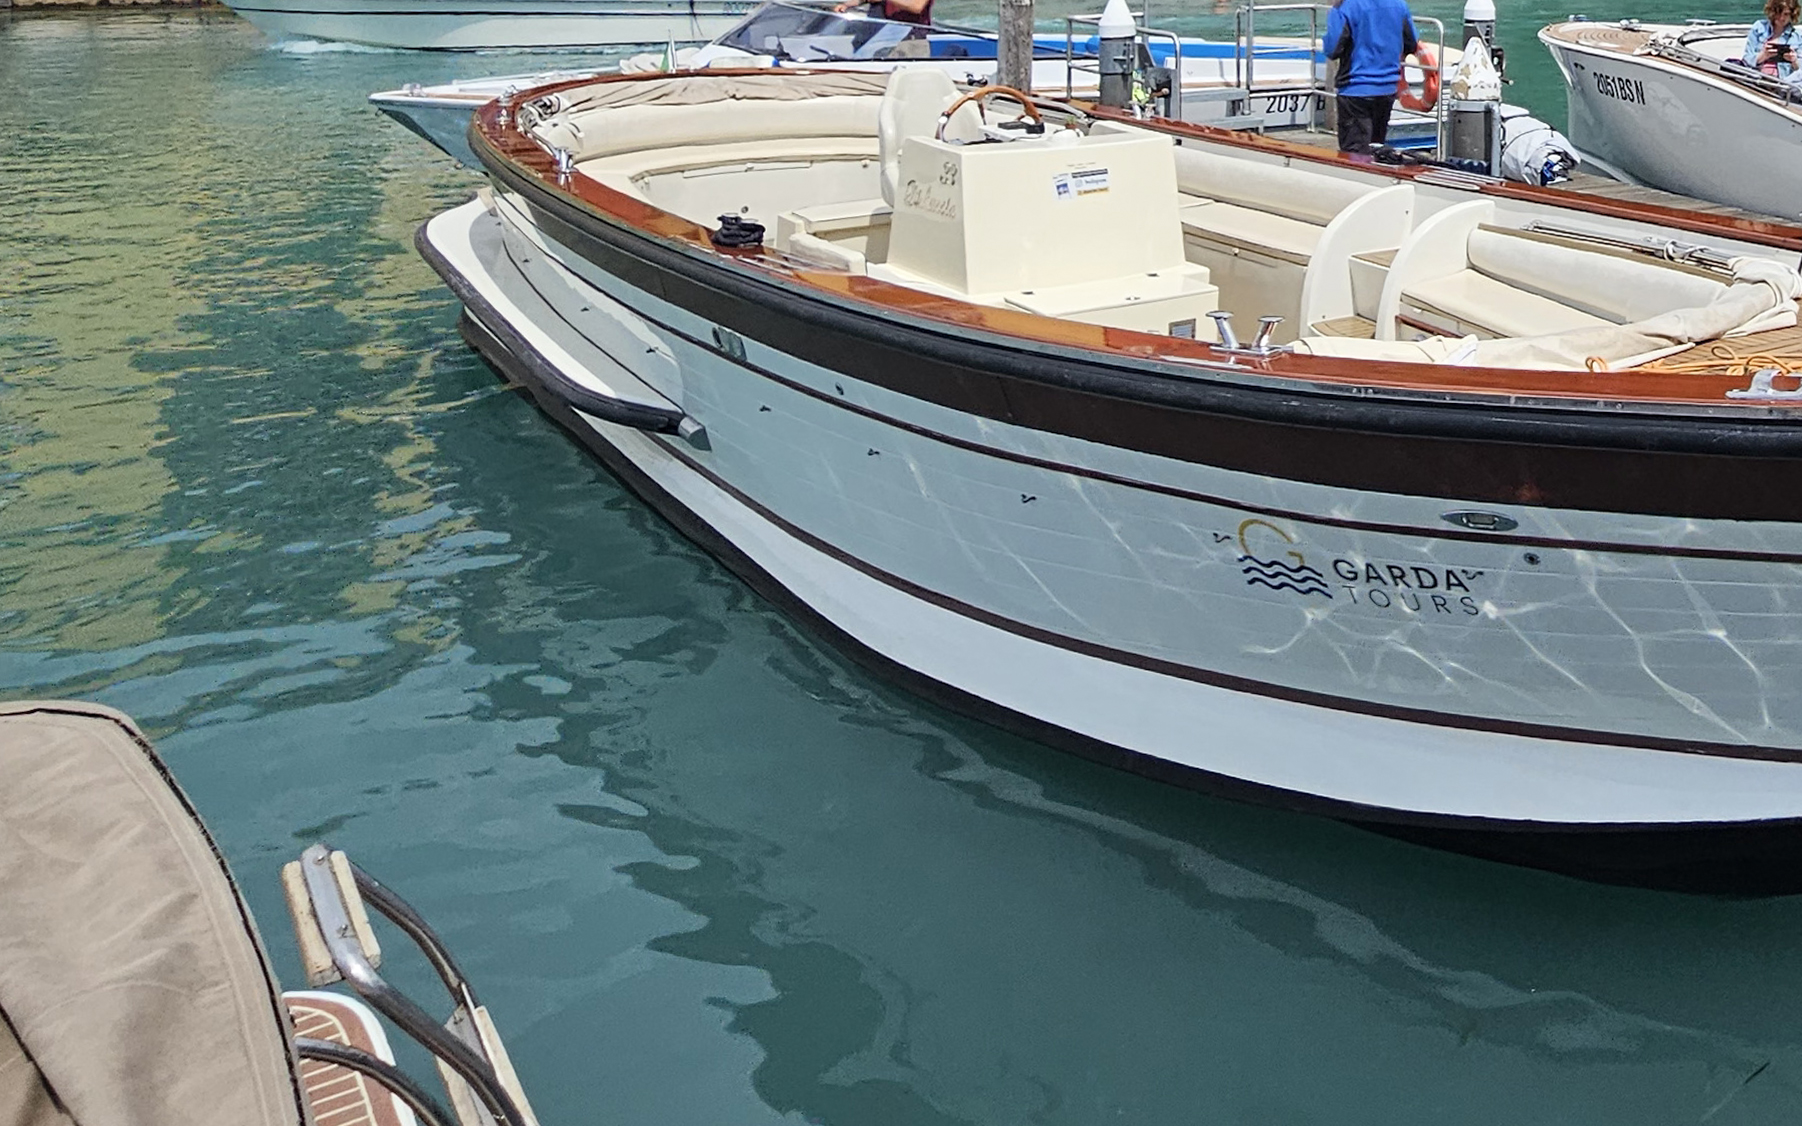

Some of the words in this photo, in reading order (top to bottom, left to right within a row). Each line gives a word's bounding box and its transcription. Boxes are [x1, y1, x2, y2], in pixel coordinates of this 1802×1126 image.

[1266, 94, 1311, 114] 2037
[1333, 559, 1470, 592] GARDA
[1342, 585, 1480, 616] TOURS
